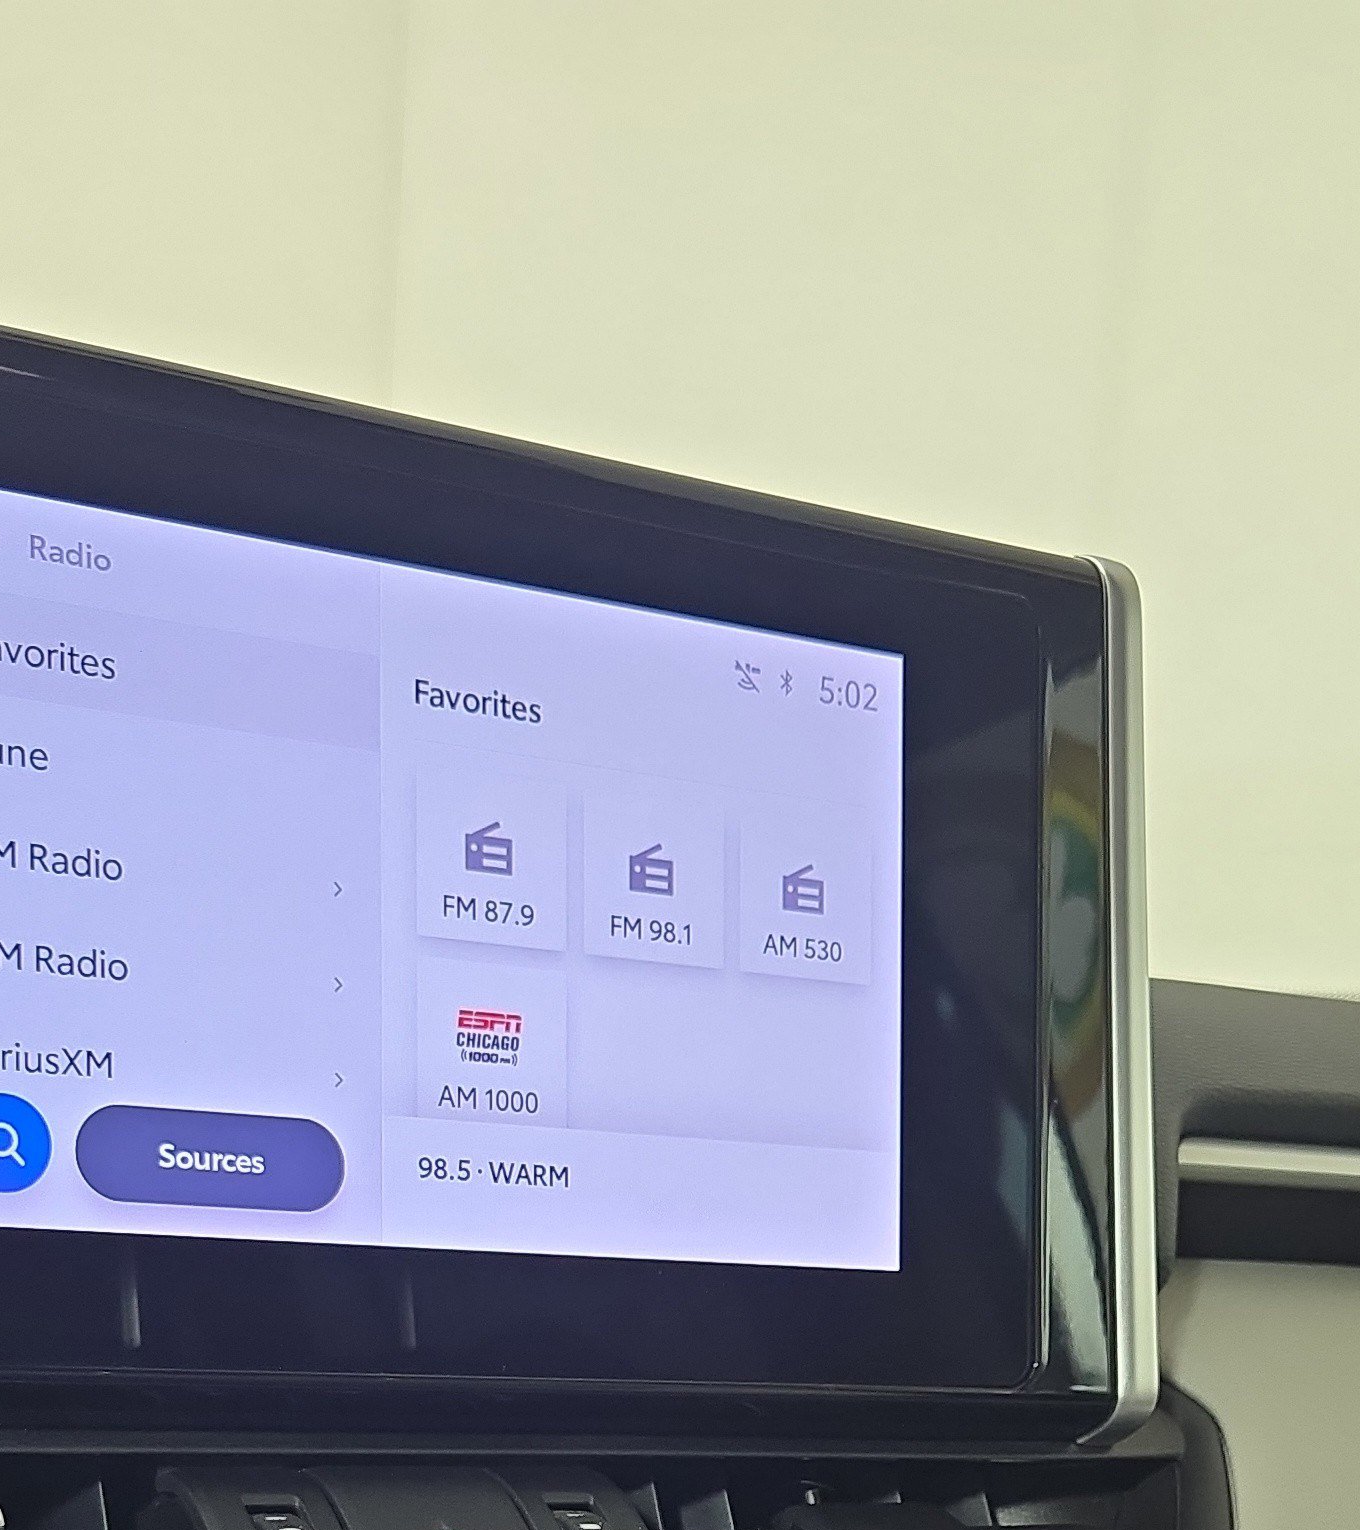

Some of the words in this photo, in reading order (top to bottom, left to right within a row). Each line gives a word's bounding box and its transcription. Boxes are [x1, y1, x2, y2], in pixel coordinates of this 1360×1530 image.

[29, 534, 111, 572] Radio
[414, 678, 542, 723] Favorites
[819, 676, 879, 712] 5:02
[29, 842, 123, 881] Radio
[442, 895, 477, 921] FM
[484, 901, 535, 927] 87.9
[610, 914, 642, 940] FM
[649, 921, 693, 946] 98.1
[35, 945, 129, 981] Radio
[763, 934, 798, 959] AM
[804, 938, 842, 962] 530
[458, 1009, 522, 1033] ESPN
[456, 1032, 520, 1052] CHICAGO
[469, 1051, 499, 1064] 1000
[437, 1085, 478, 1111] AM
[484, 1089, 539, 1114] 1000
[158, 1143, 265, 1175] Sources
[418, 1156, 471, 1182] 98.5
[489, 1161, 570, 1188] WARM
